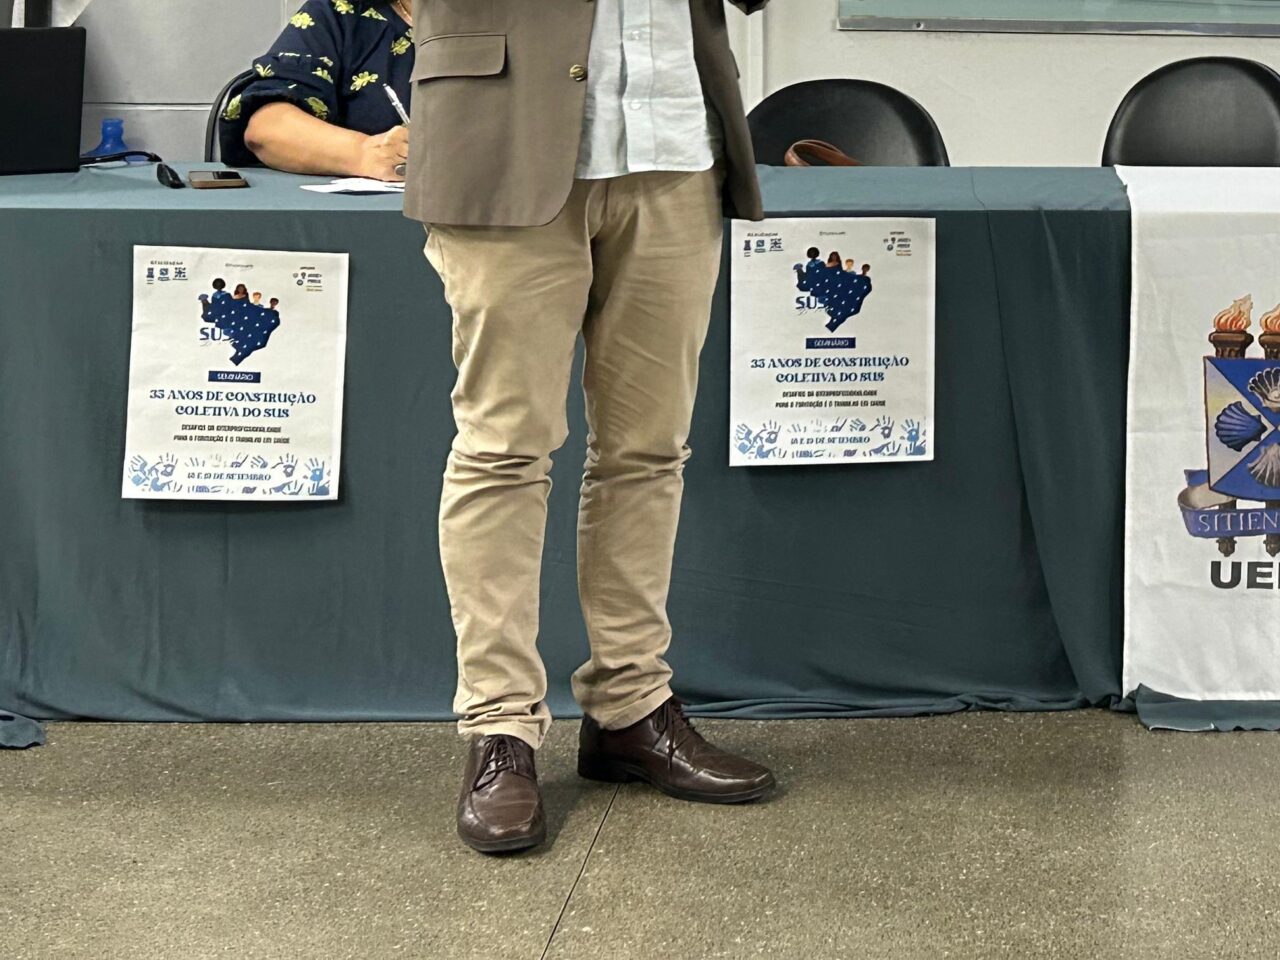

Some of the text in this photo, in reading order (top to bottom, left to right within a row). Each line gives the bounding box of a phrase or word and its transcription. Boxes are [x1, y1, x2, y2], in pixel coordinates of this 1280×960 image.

[768, 357, 802, 368] ANOS
[804, 357, 821, 368] DE
[822, 354, 909, 370] CONSTRUÇÃO
[776, 371, 885, 383] COLETIVA DO SUS
[167, 390, 204, 401] ANOS
[205, 391, 224, 401] DE
[225, 390, 317, 406] CONSTRUÇÃO
[175, 405, 290, 418] COLETIVA DO SUS
